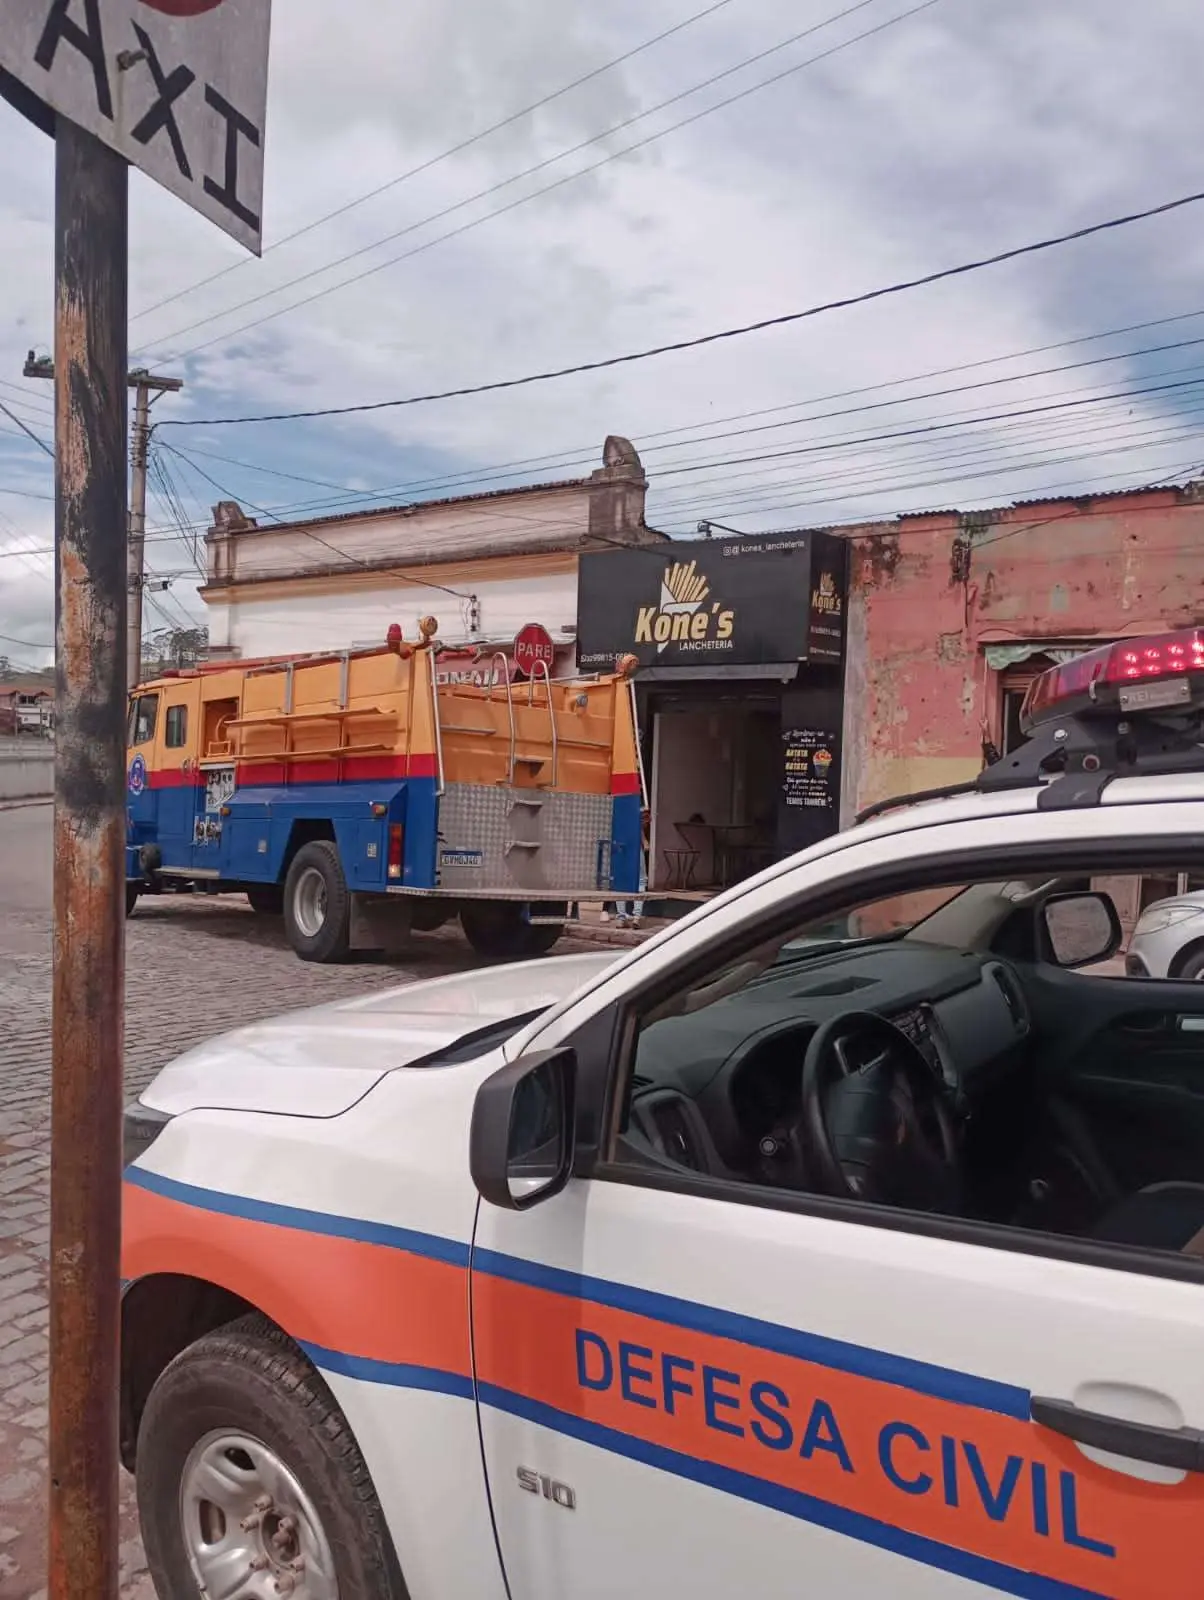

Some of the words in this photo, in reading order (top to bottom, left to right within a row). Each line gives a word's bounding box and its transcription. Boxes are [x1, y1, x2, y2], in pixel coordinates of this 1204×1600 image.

[634, 602, 735, 644] Kone's
[517, 642, 551, 658] PARE
[679, 639, 734, 651] LANCHETERIA
[574, 1328, 855, 1475] DEFESA
[877, 1420, 1117, 1558] CIVIL
[516, 1465, 577, 1510] S10
